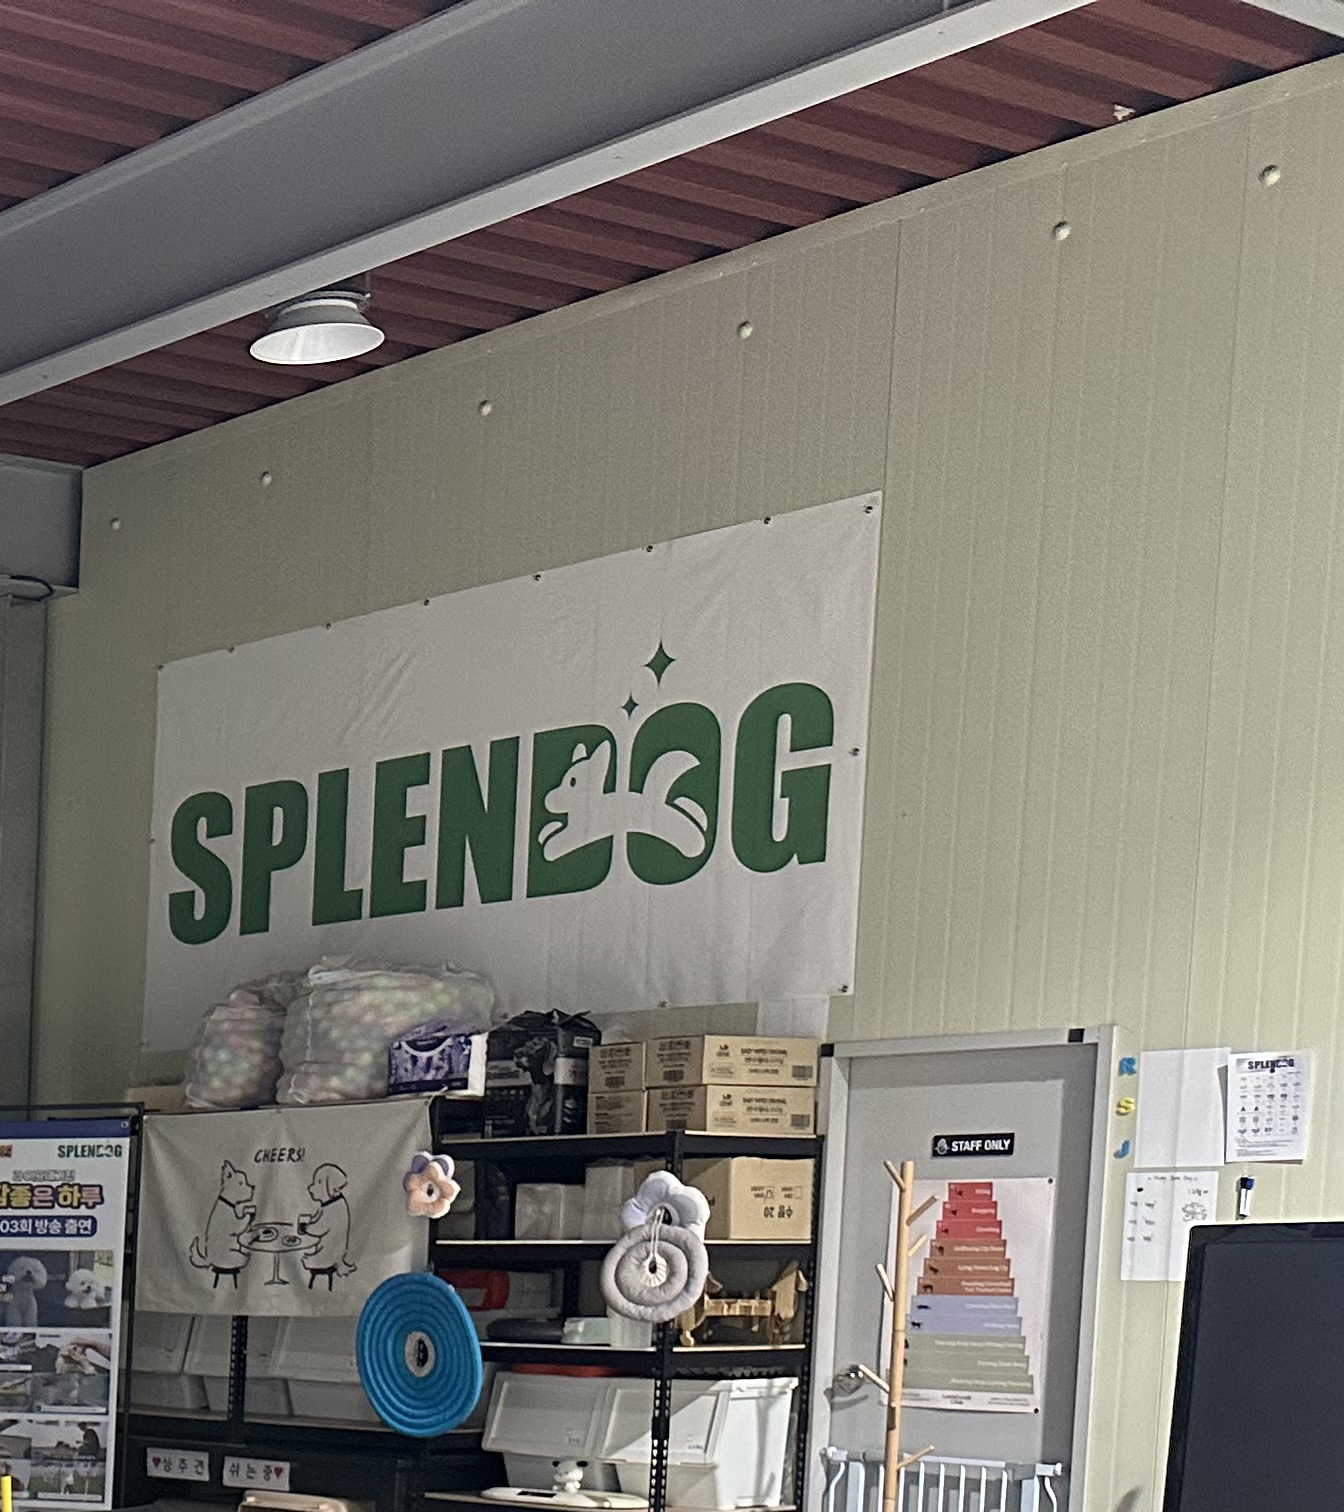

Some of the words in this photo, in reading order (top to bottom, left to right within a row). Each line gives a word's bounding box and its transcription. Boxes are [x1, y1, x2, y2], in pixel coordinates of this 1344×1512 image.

[168, 681, 835, 946] SPLENDOG
[951, 1140, 983, 1152] STAFF
[984, 1138, 1011, 1151] ONLY
[253, 1147, 306, 1164] CHEERS!
[56, 1182, 105, 1209] 하루
[34, 1218, 61, 1234] 방송
[65, 1218, 92, 1234] 출연
